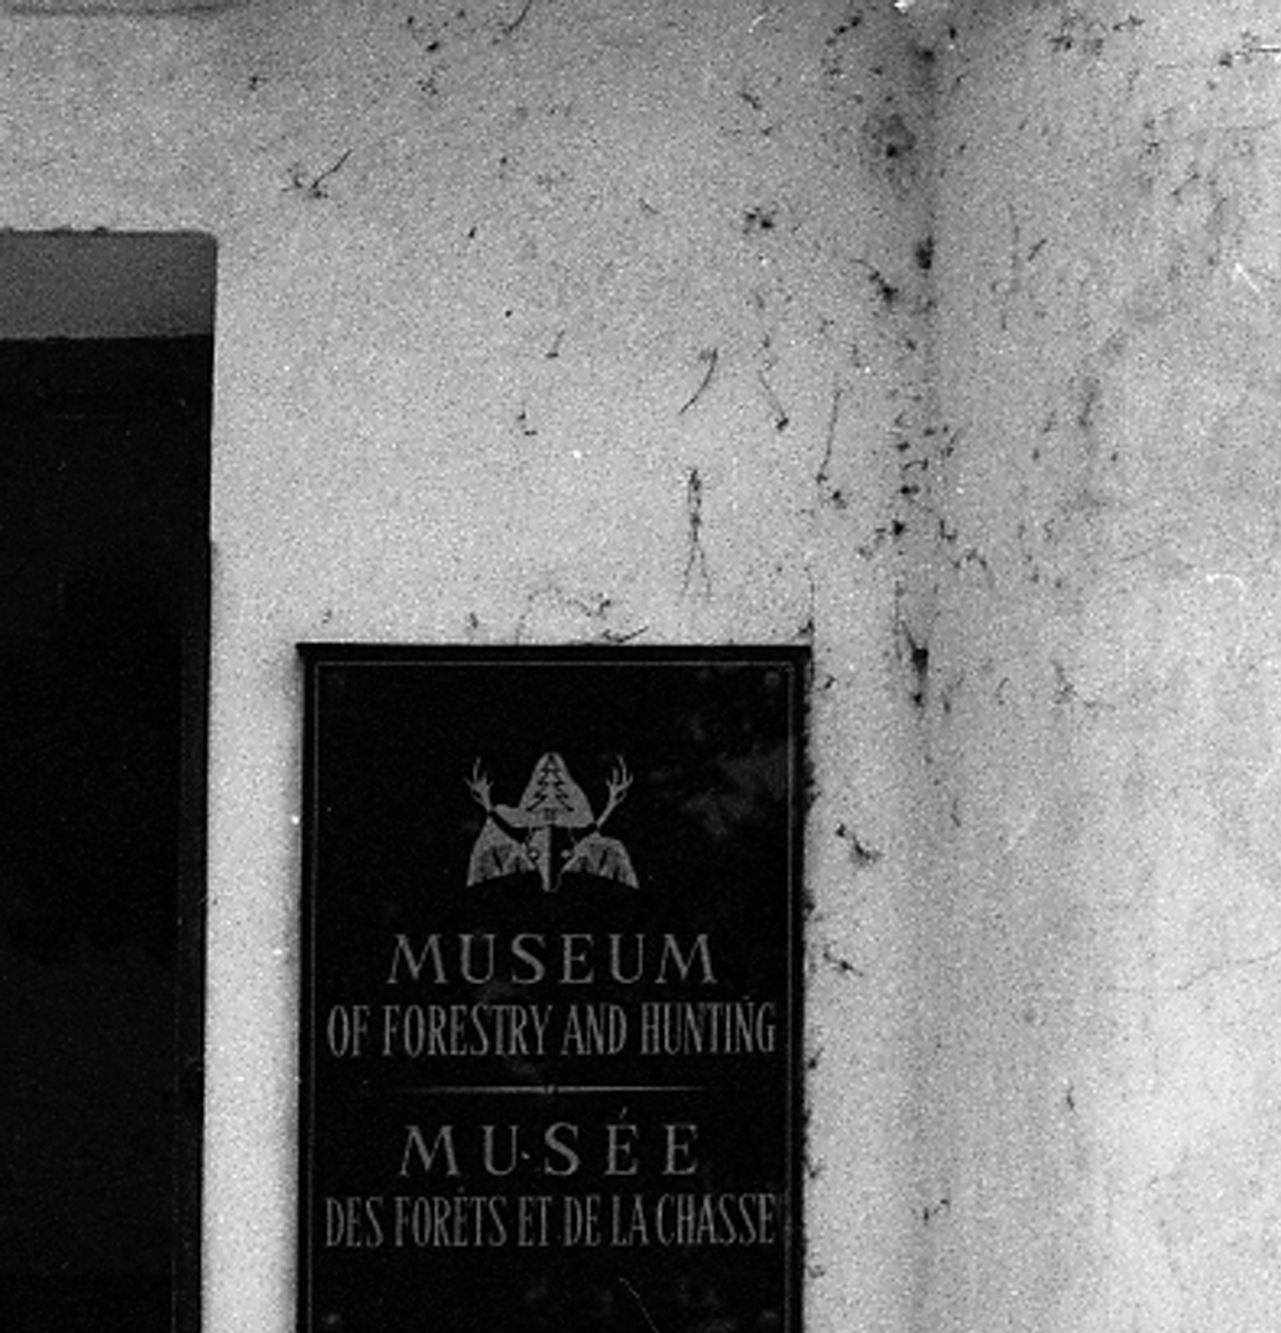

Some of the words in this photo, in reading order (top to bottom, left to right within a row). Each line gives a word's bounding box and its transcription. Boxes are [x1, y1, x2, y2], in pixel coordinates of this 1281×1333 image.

[387, 933, 718, 984] MUSEUM
[327, 1004, 371, 1057] OF
[382, 1002, 553, 1057] FORESTRY
[560, 1003, 627, 1056] AND
[640, 1001, 777, 1055] HUNTING
[399, 1107, 697, 1176] MUSÉE
[326, 1196, 384, 1247] DES
[517, 1196, 552, 1247] ET
[564, 1194, 600, 1246] DE
[611, 1194, 650, 1246] LA
[655, 1193, 777, 1245] CHASSE
